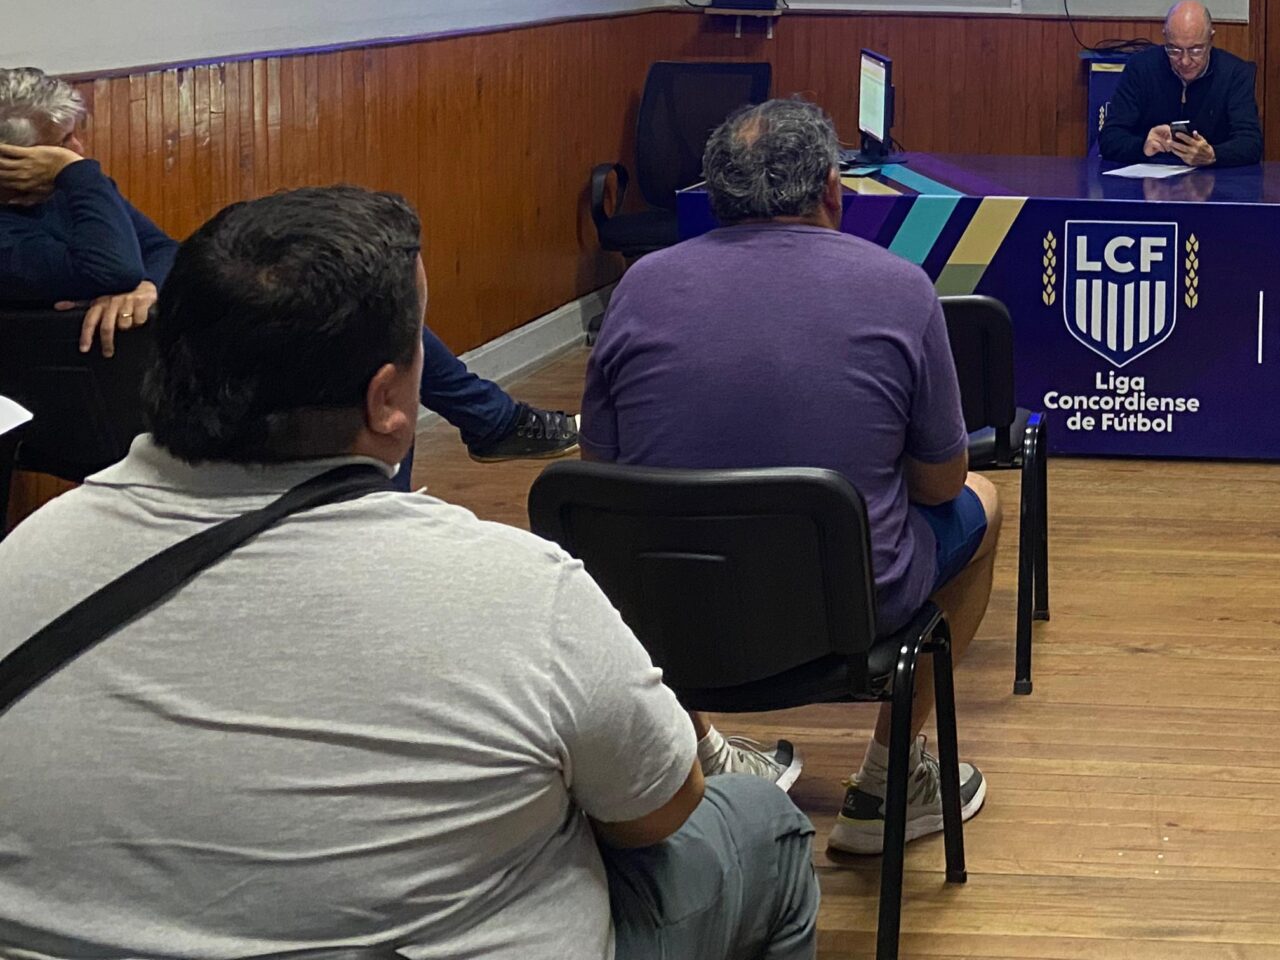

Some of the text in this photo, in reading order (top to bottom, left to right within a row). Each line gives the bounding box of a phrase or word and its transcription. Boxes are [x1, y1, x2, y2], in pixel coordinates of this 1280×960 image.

[1076, 235, 1168, 274] LCF
[1095, 370, 1145, 395] Liga
[1043, 391, 1200, 413] Concordiense
[1066, 411, 1173, 433] de Fútbol
